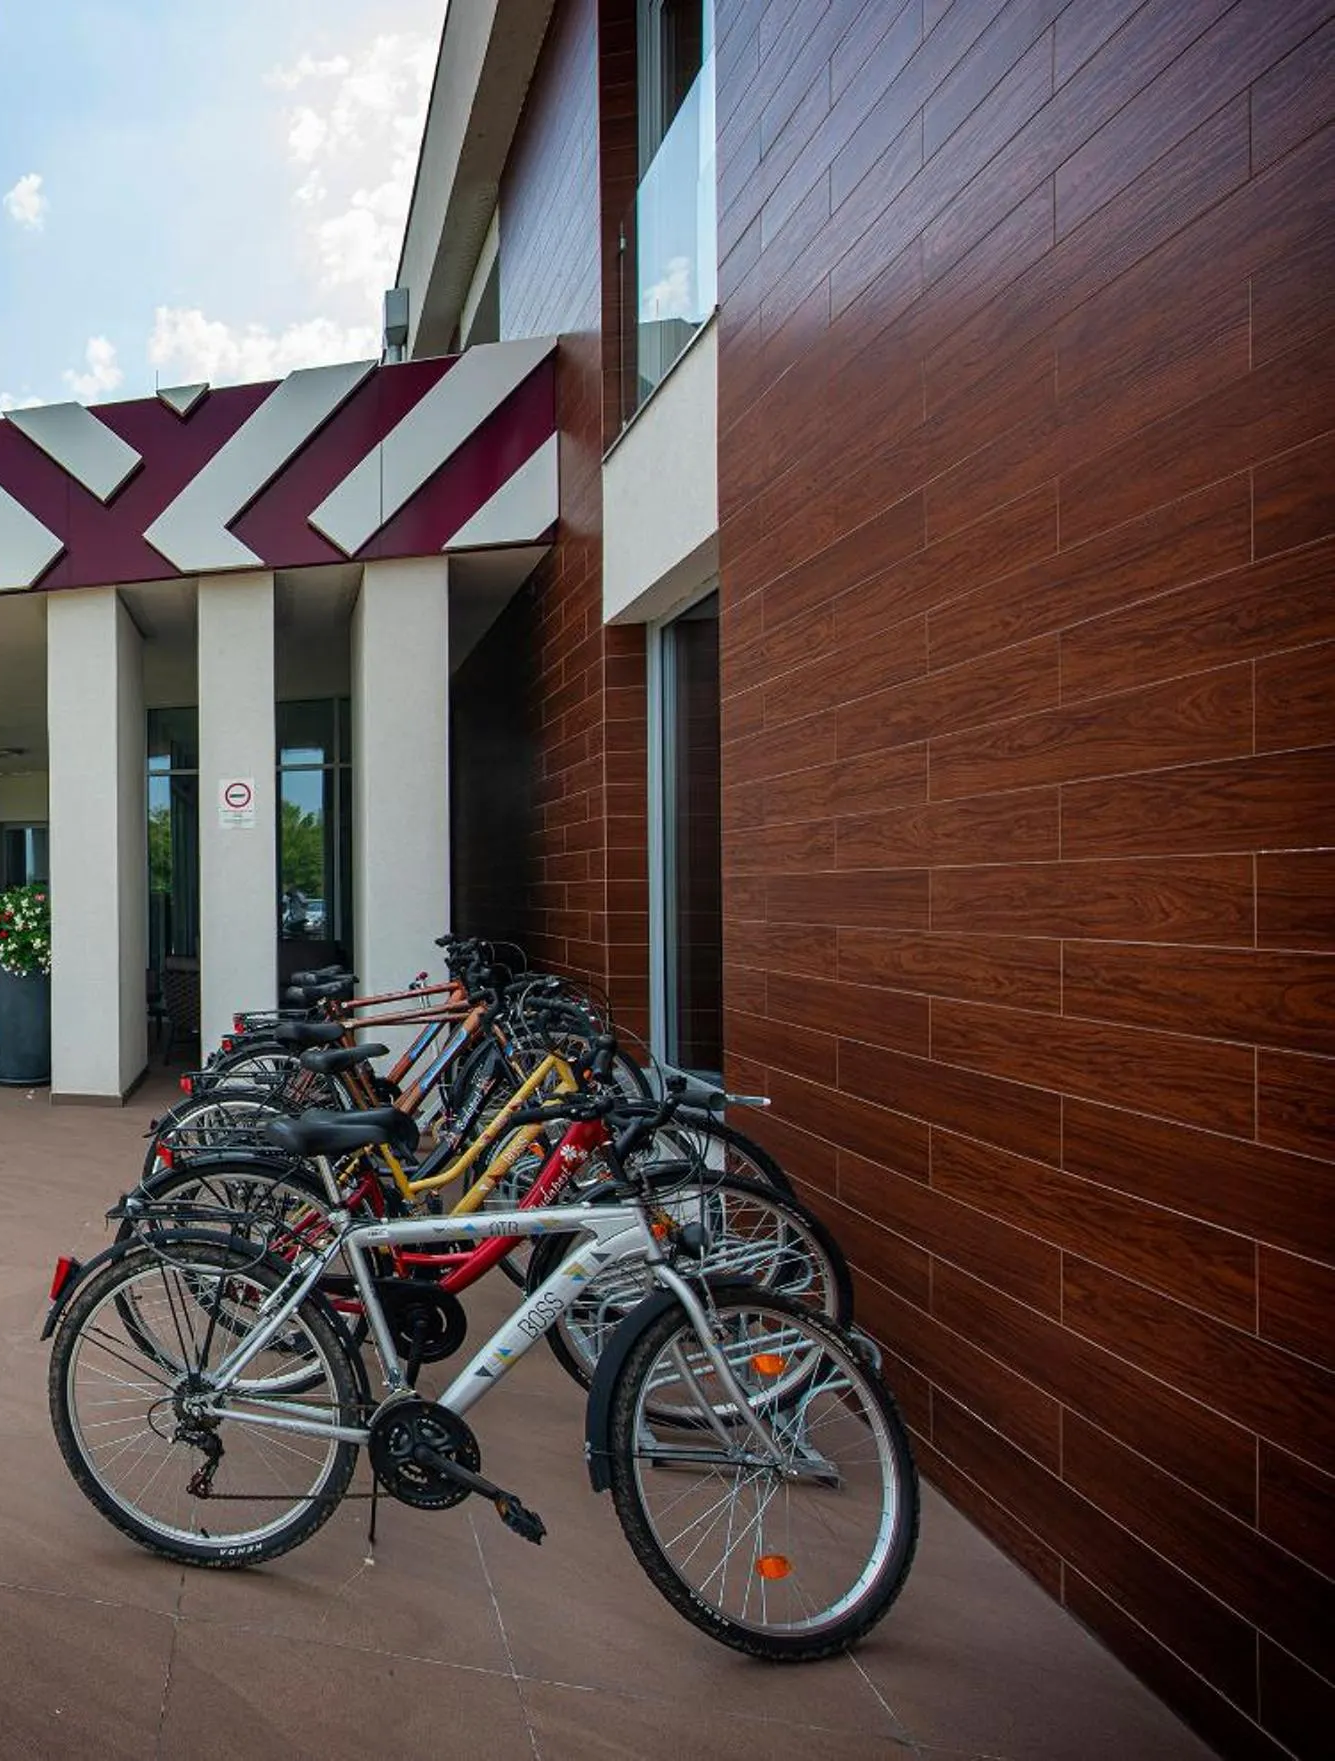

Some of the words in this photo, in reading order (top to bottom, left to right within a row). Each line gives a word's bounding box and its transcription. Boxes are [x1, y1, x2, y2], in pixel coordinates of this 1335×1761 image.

[530, 1165, 572, 1208] udapest
[517, 1292, 564, 1339] BOSS
[219, 1542, 262, 1556] KENDA
